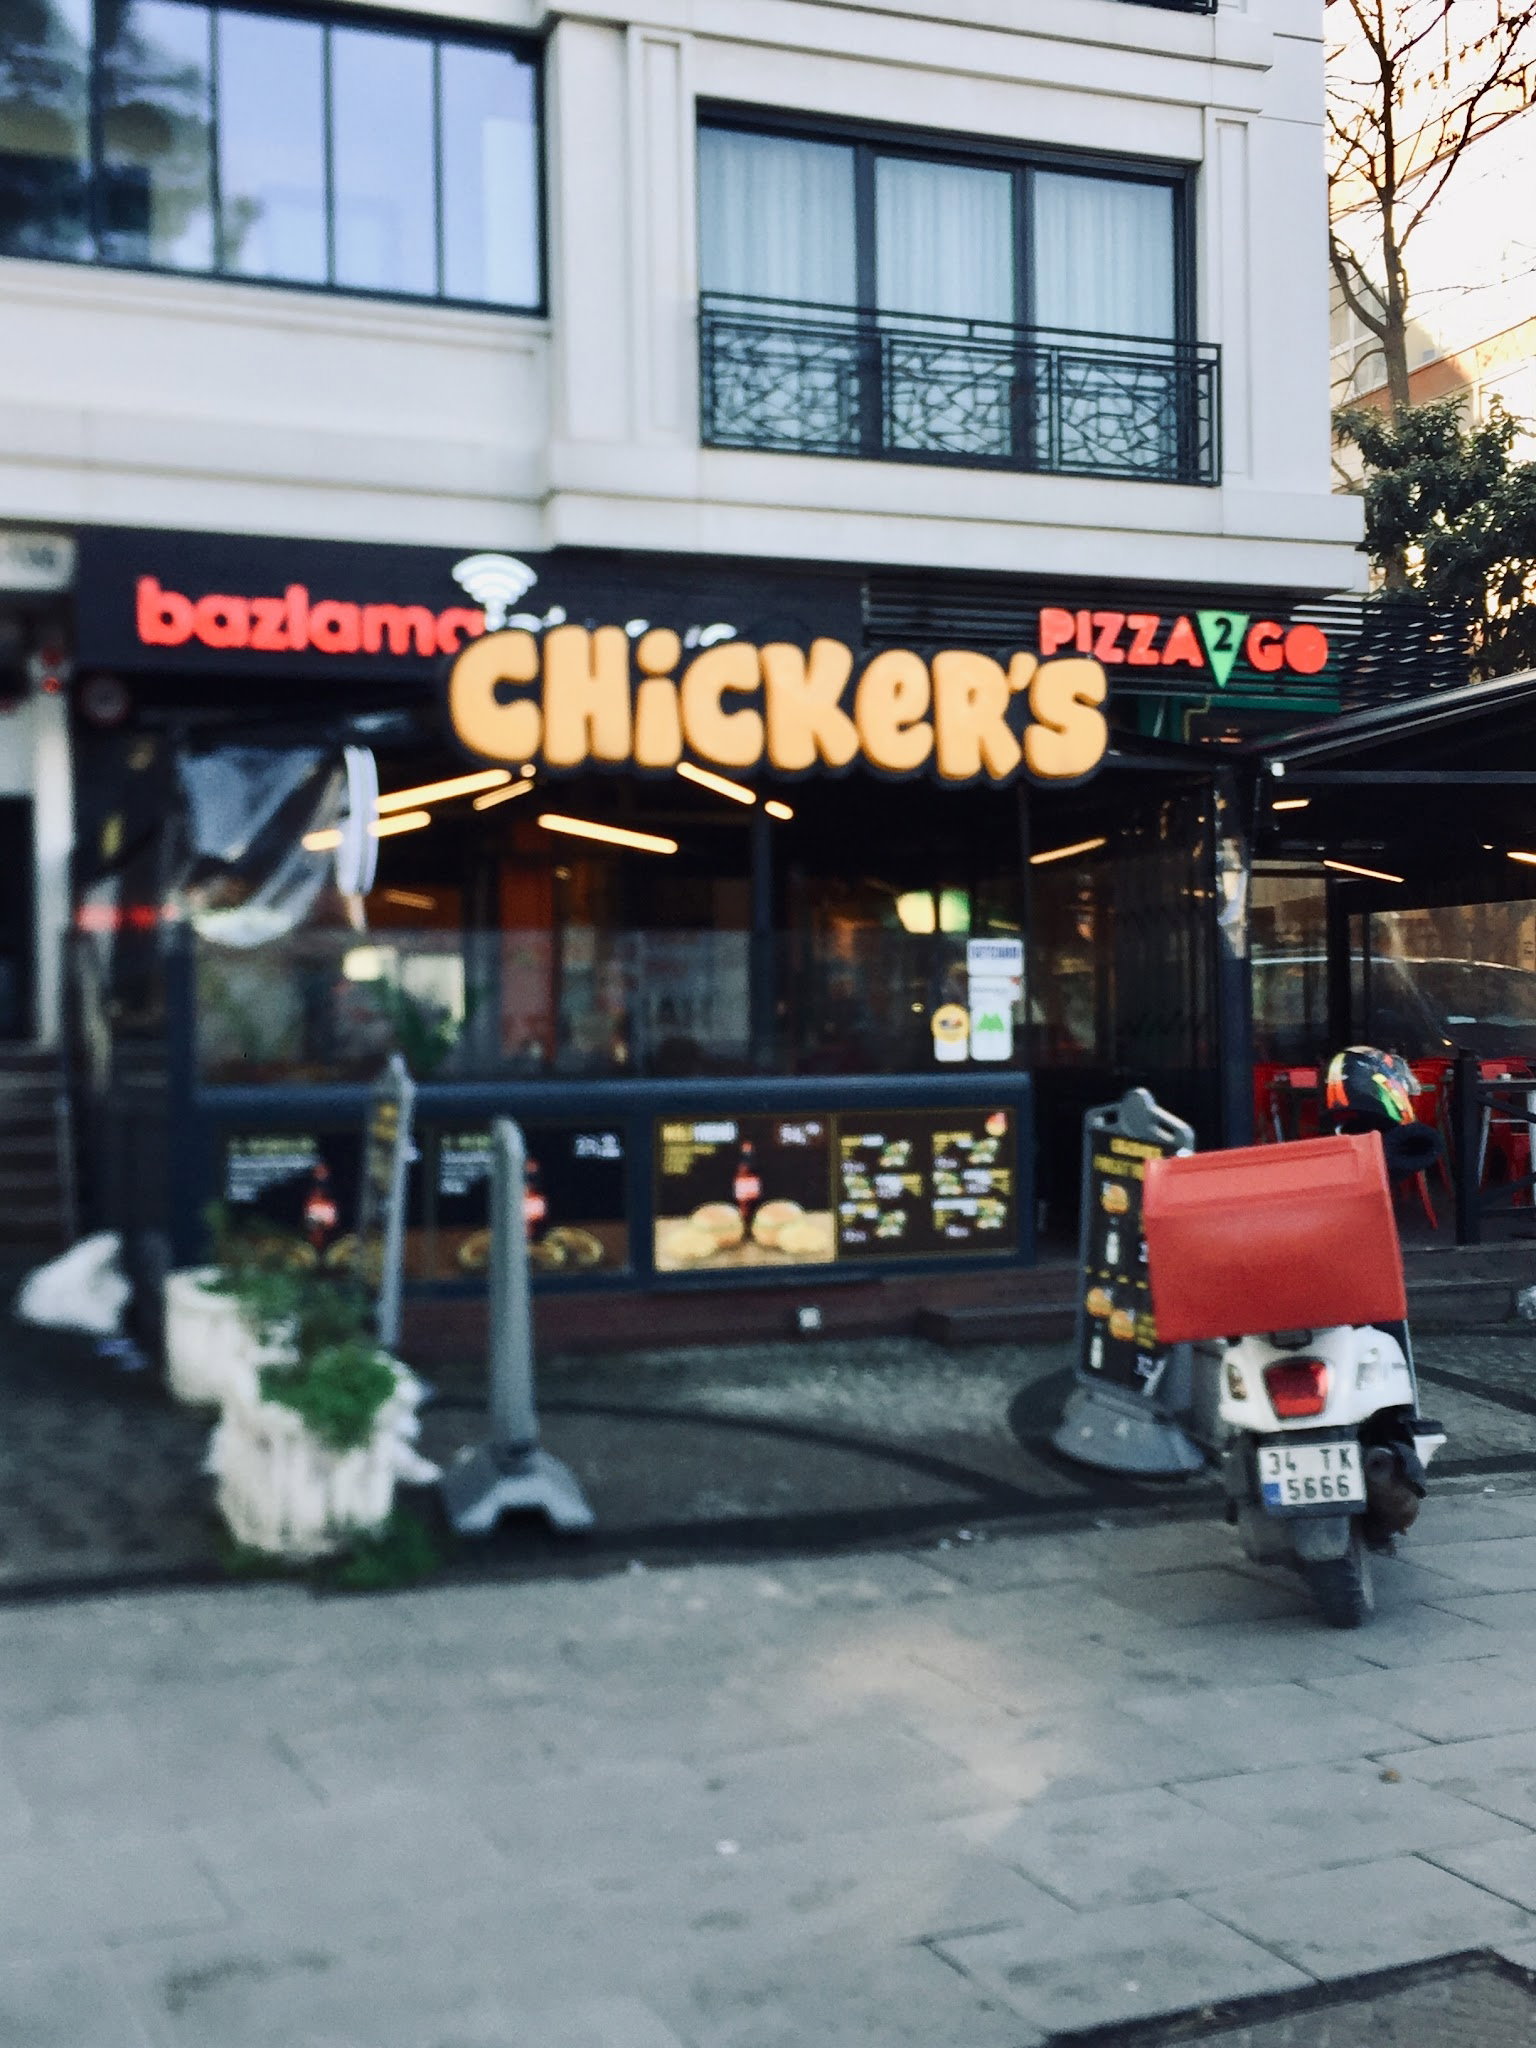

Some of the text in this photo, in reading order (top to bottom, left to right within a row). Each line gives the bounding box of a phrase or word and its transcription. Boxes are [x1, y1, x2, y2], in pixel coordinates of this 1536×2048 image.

[1039, 607, 1204, 668] PIZZA
[1246, 619, 1329, 674] GO
[1267, 1447, 1352, 1475] 34 TK
[1286, 1474, 1350, 1501] 5666
